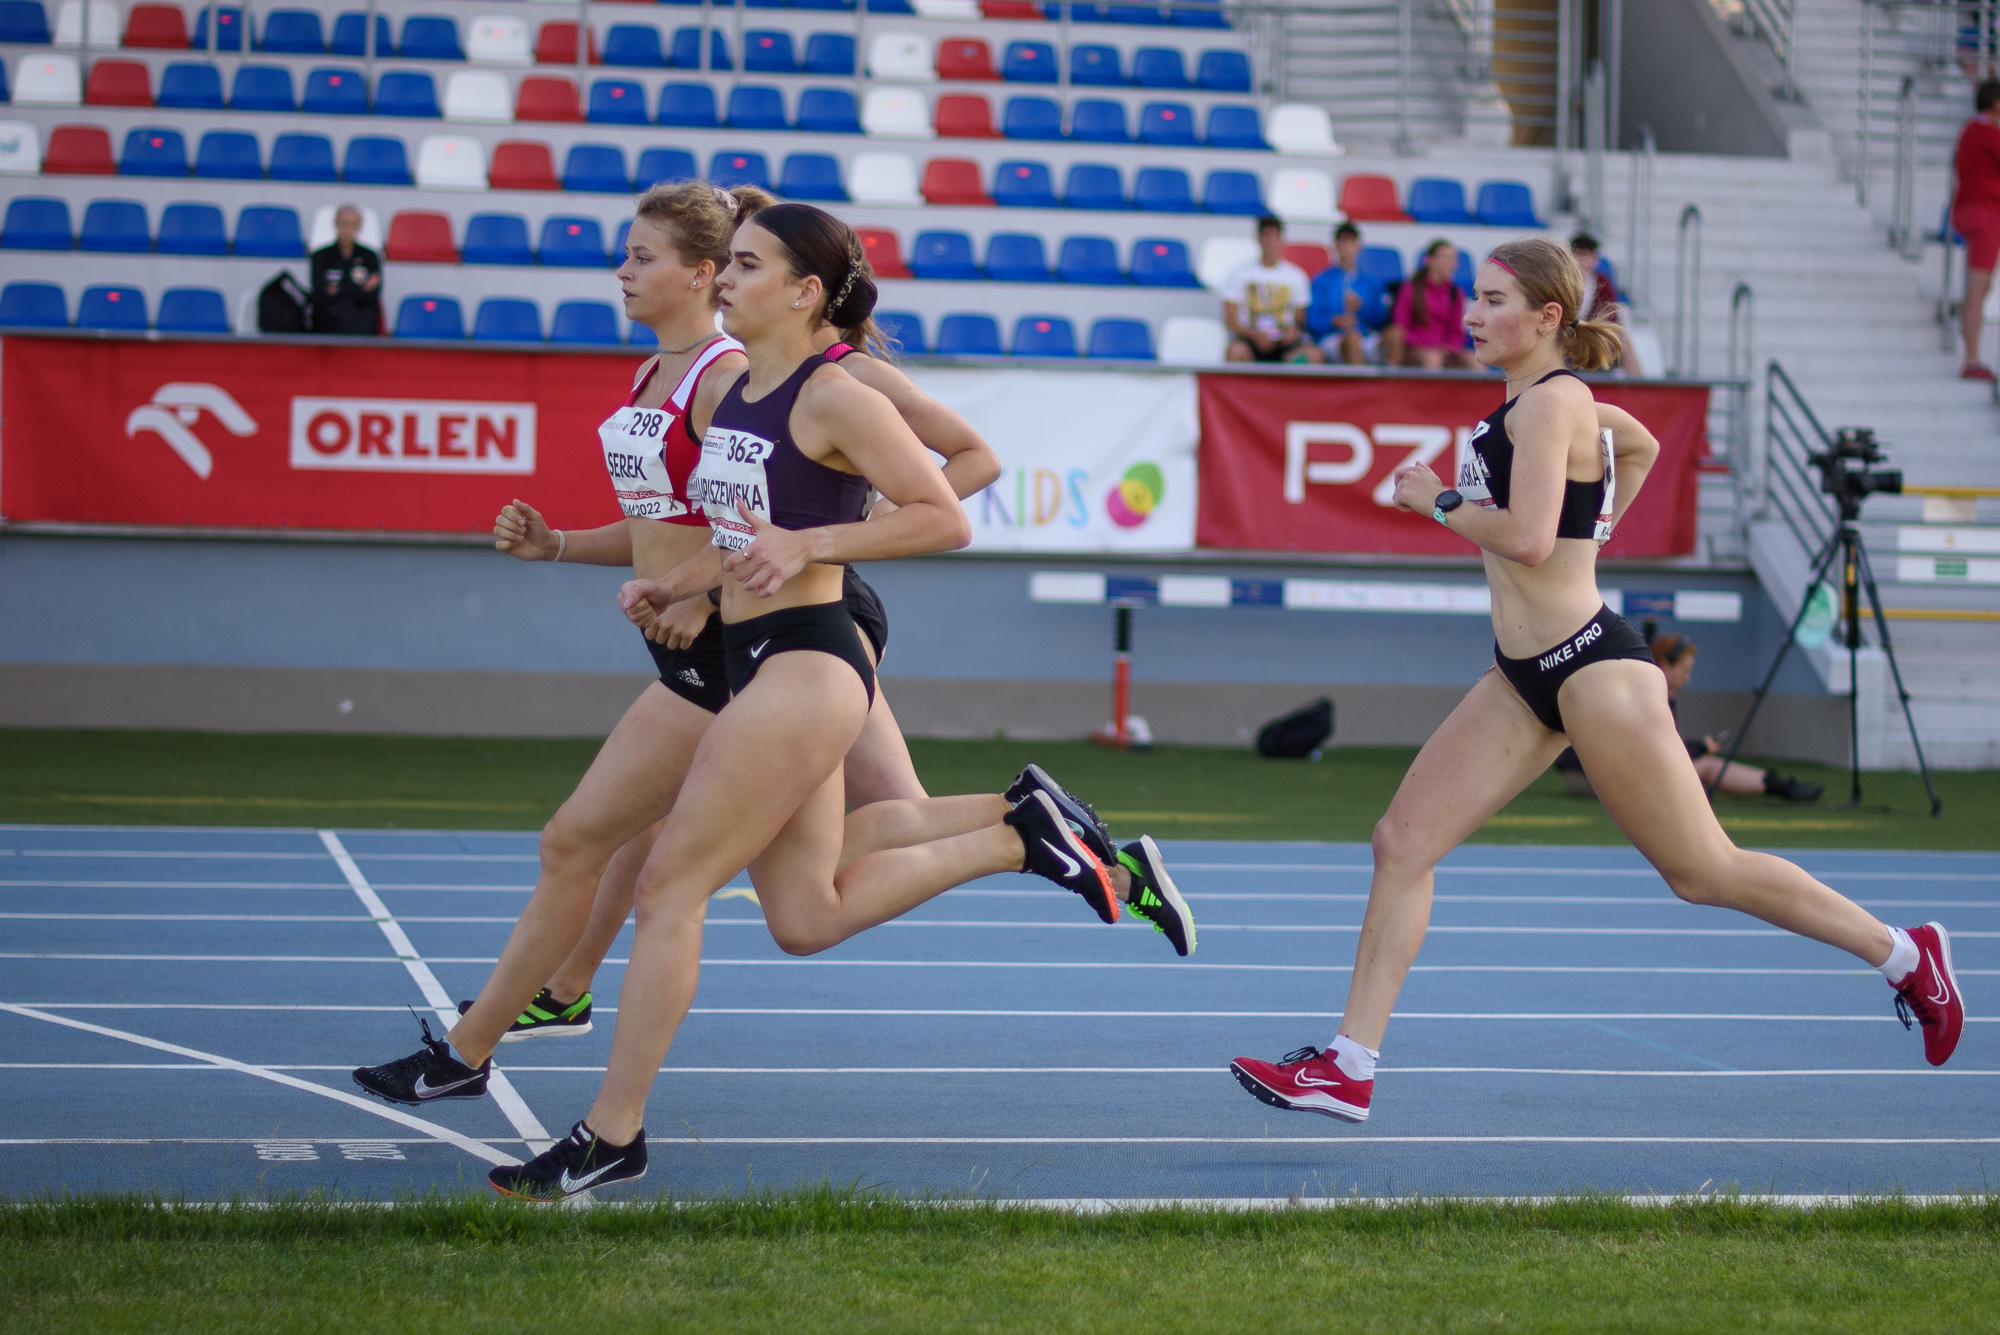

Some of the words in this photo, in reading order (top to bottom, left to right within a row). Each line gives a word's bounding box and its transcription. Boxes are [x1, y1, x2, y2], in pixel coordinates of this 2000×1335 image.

[306, 409, 517, 461] ORLEN
[629, 411, 664, 438] 298
[727, 434, 764, 465] 362
[607, 451, 648, 481] SEREK
[635, 501, 662, 516] 2022
[980, 467, 1090, 528] KIDS
[1539, 646, 1574, 672] NIKE
[1575, 622, 1603, 653] PRO
